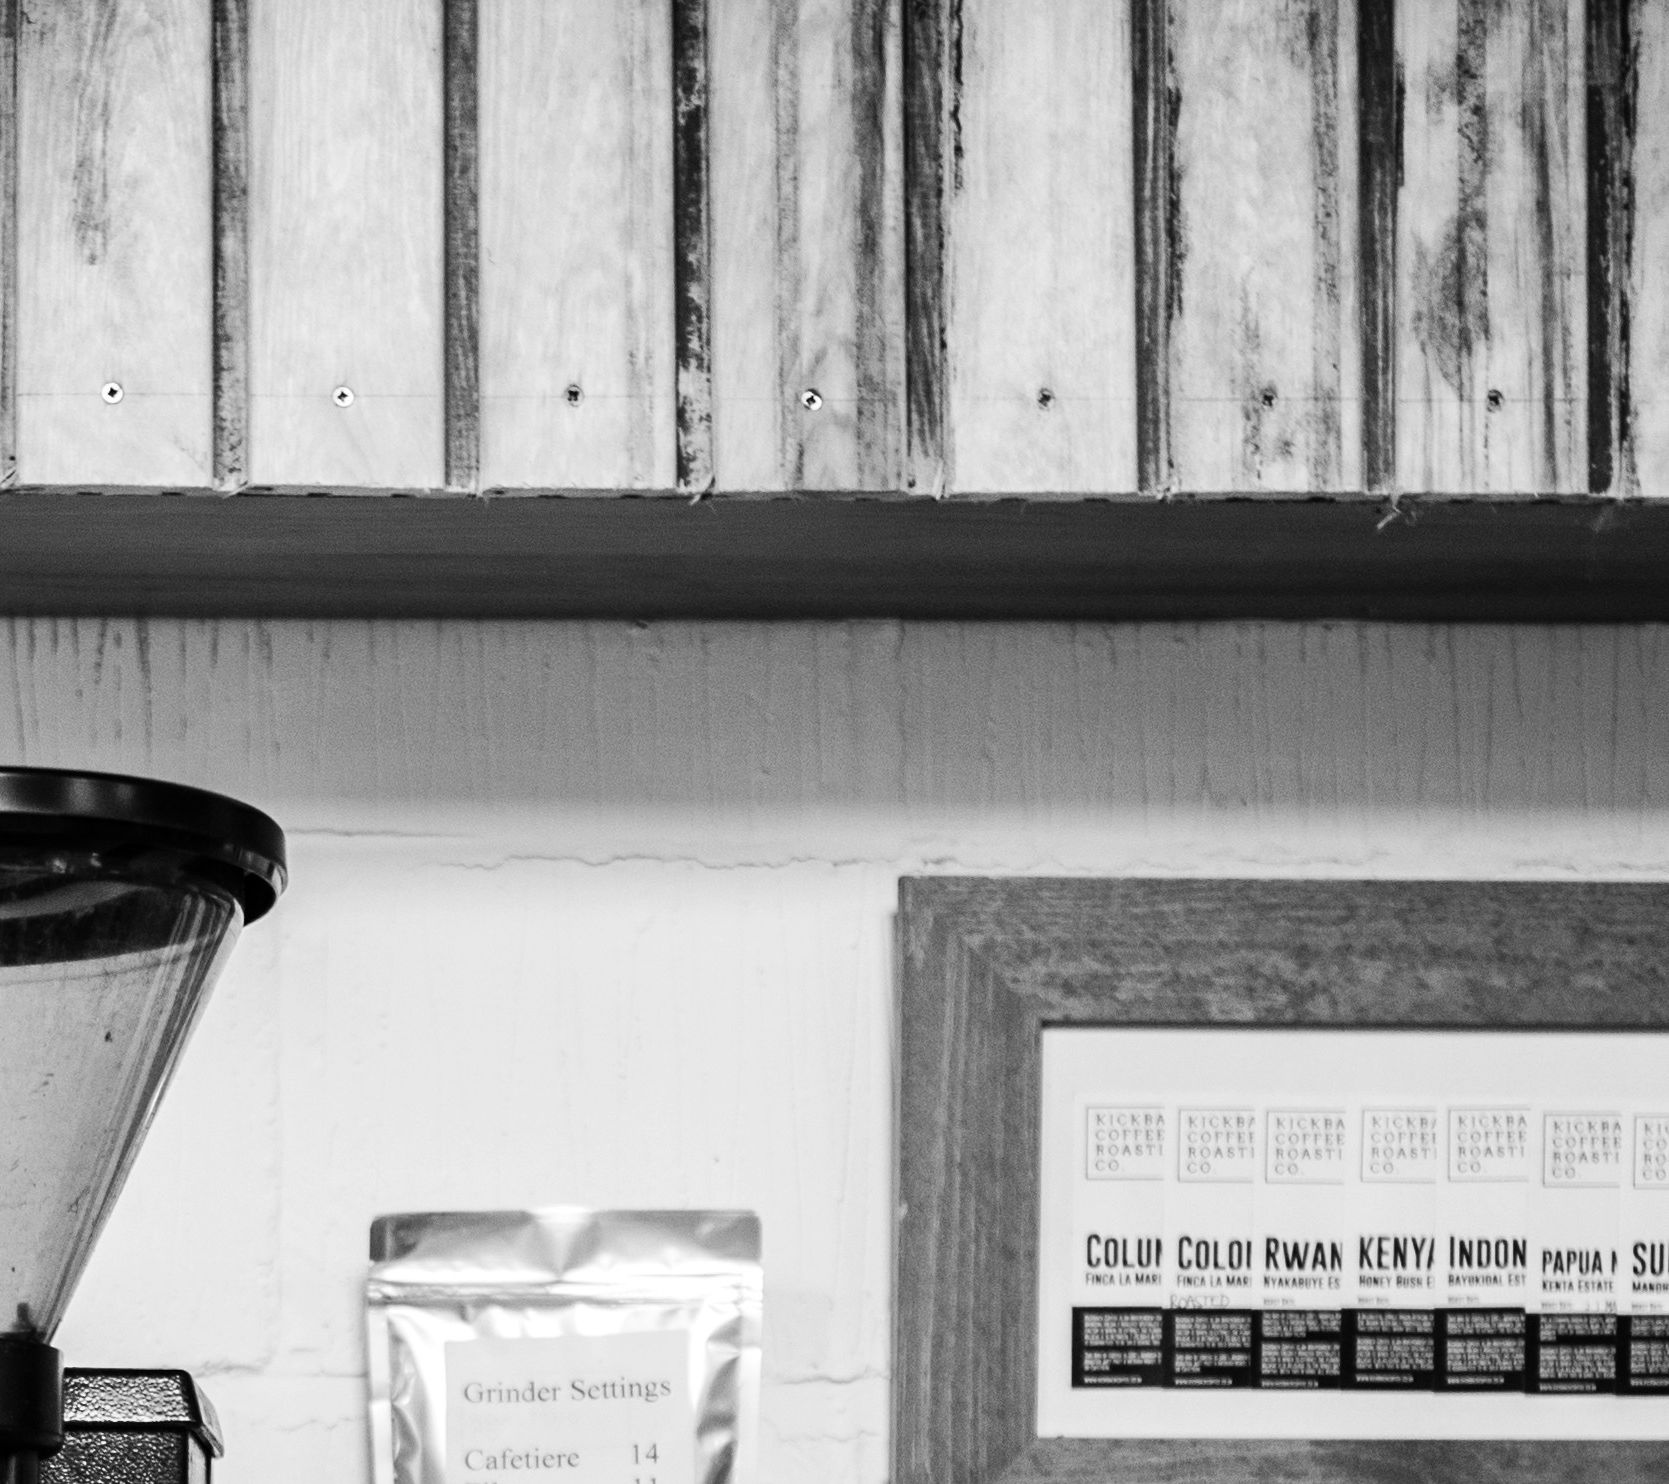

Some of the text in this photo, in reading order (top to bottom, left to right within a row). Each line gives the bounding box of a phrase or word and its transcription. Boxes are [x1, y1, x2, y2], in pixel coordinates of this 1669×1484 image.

[1095, 1129, 1164, 1142] COFFEE
[1275, 1133, 1345, 1146] COFFEE
[1542, 1249, 1603, 1276] PAPUA
[1086, 1272, 1115, 1287] FINCA
[1119, 1272, 1132, 1286] LA
[1177, 1275, 1206, 1289] FINCA
[1210, 1275, 1223, 1289] LA
[463, 1378, 671, 1404] Grinder Settings
[464, 1445, 658, 1472] Cafetiere 14
